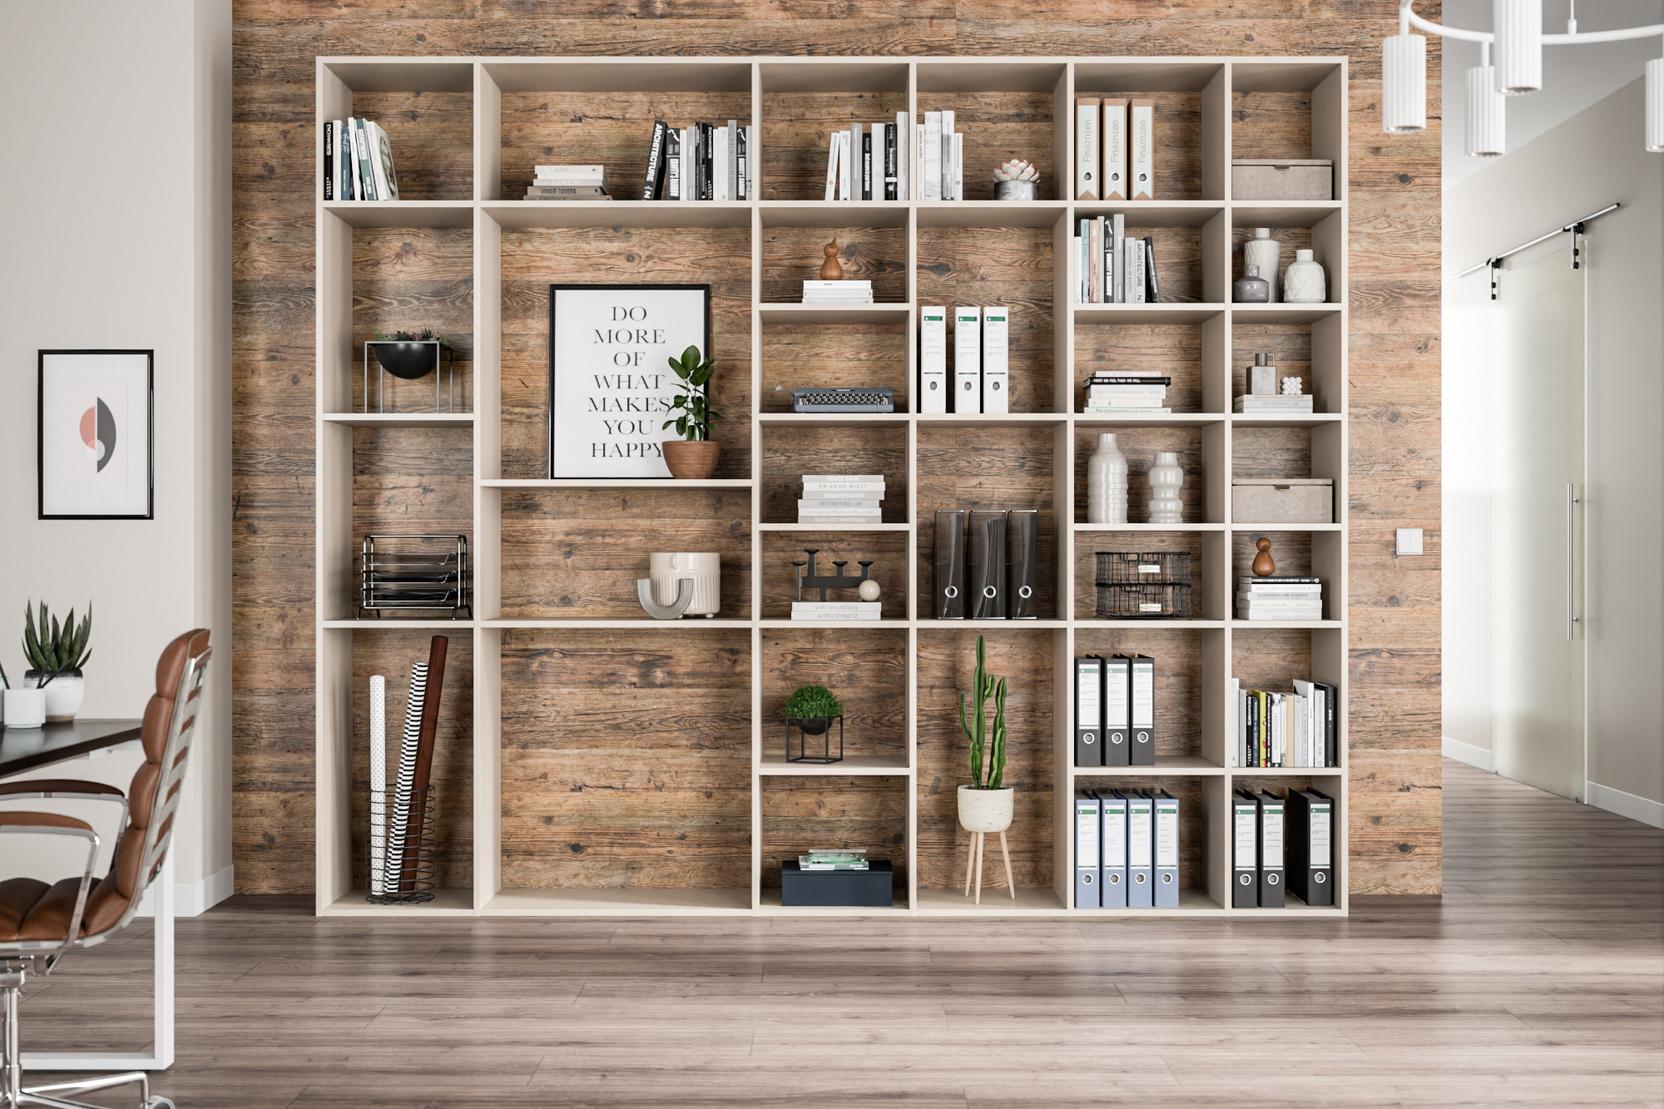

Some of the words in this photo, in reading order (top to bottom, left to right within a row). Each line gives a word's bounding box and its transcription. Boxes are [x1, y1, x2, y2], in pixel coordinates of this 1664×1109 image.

[646, 123, 663, 182] ARCHITECTURE
[611, 306, 647, 321] DO
[593, 329, 666, 344] MORE
[613, 351, 646, 367] OF
[593, 374, 666, 389] WHAT
[587, 397, 670, 412] MAKES
[602, 420, 655, 435] YOU
[591, 442, 663, 458] HAPPY
